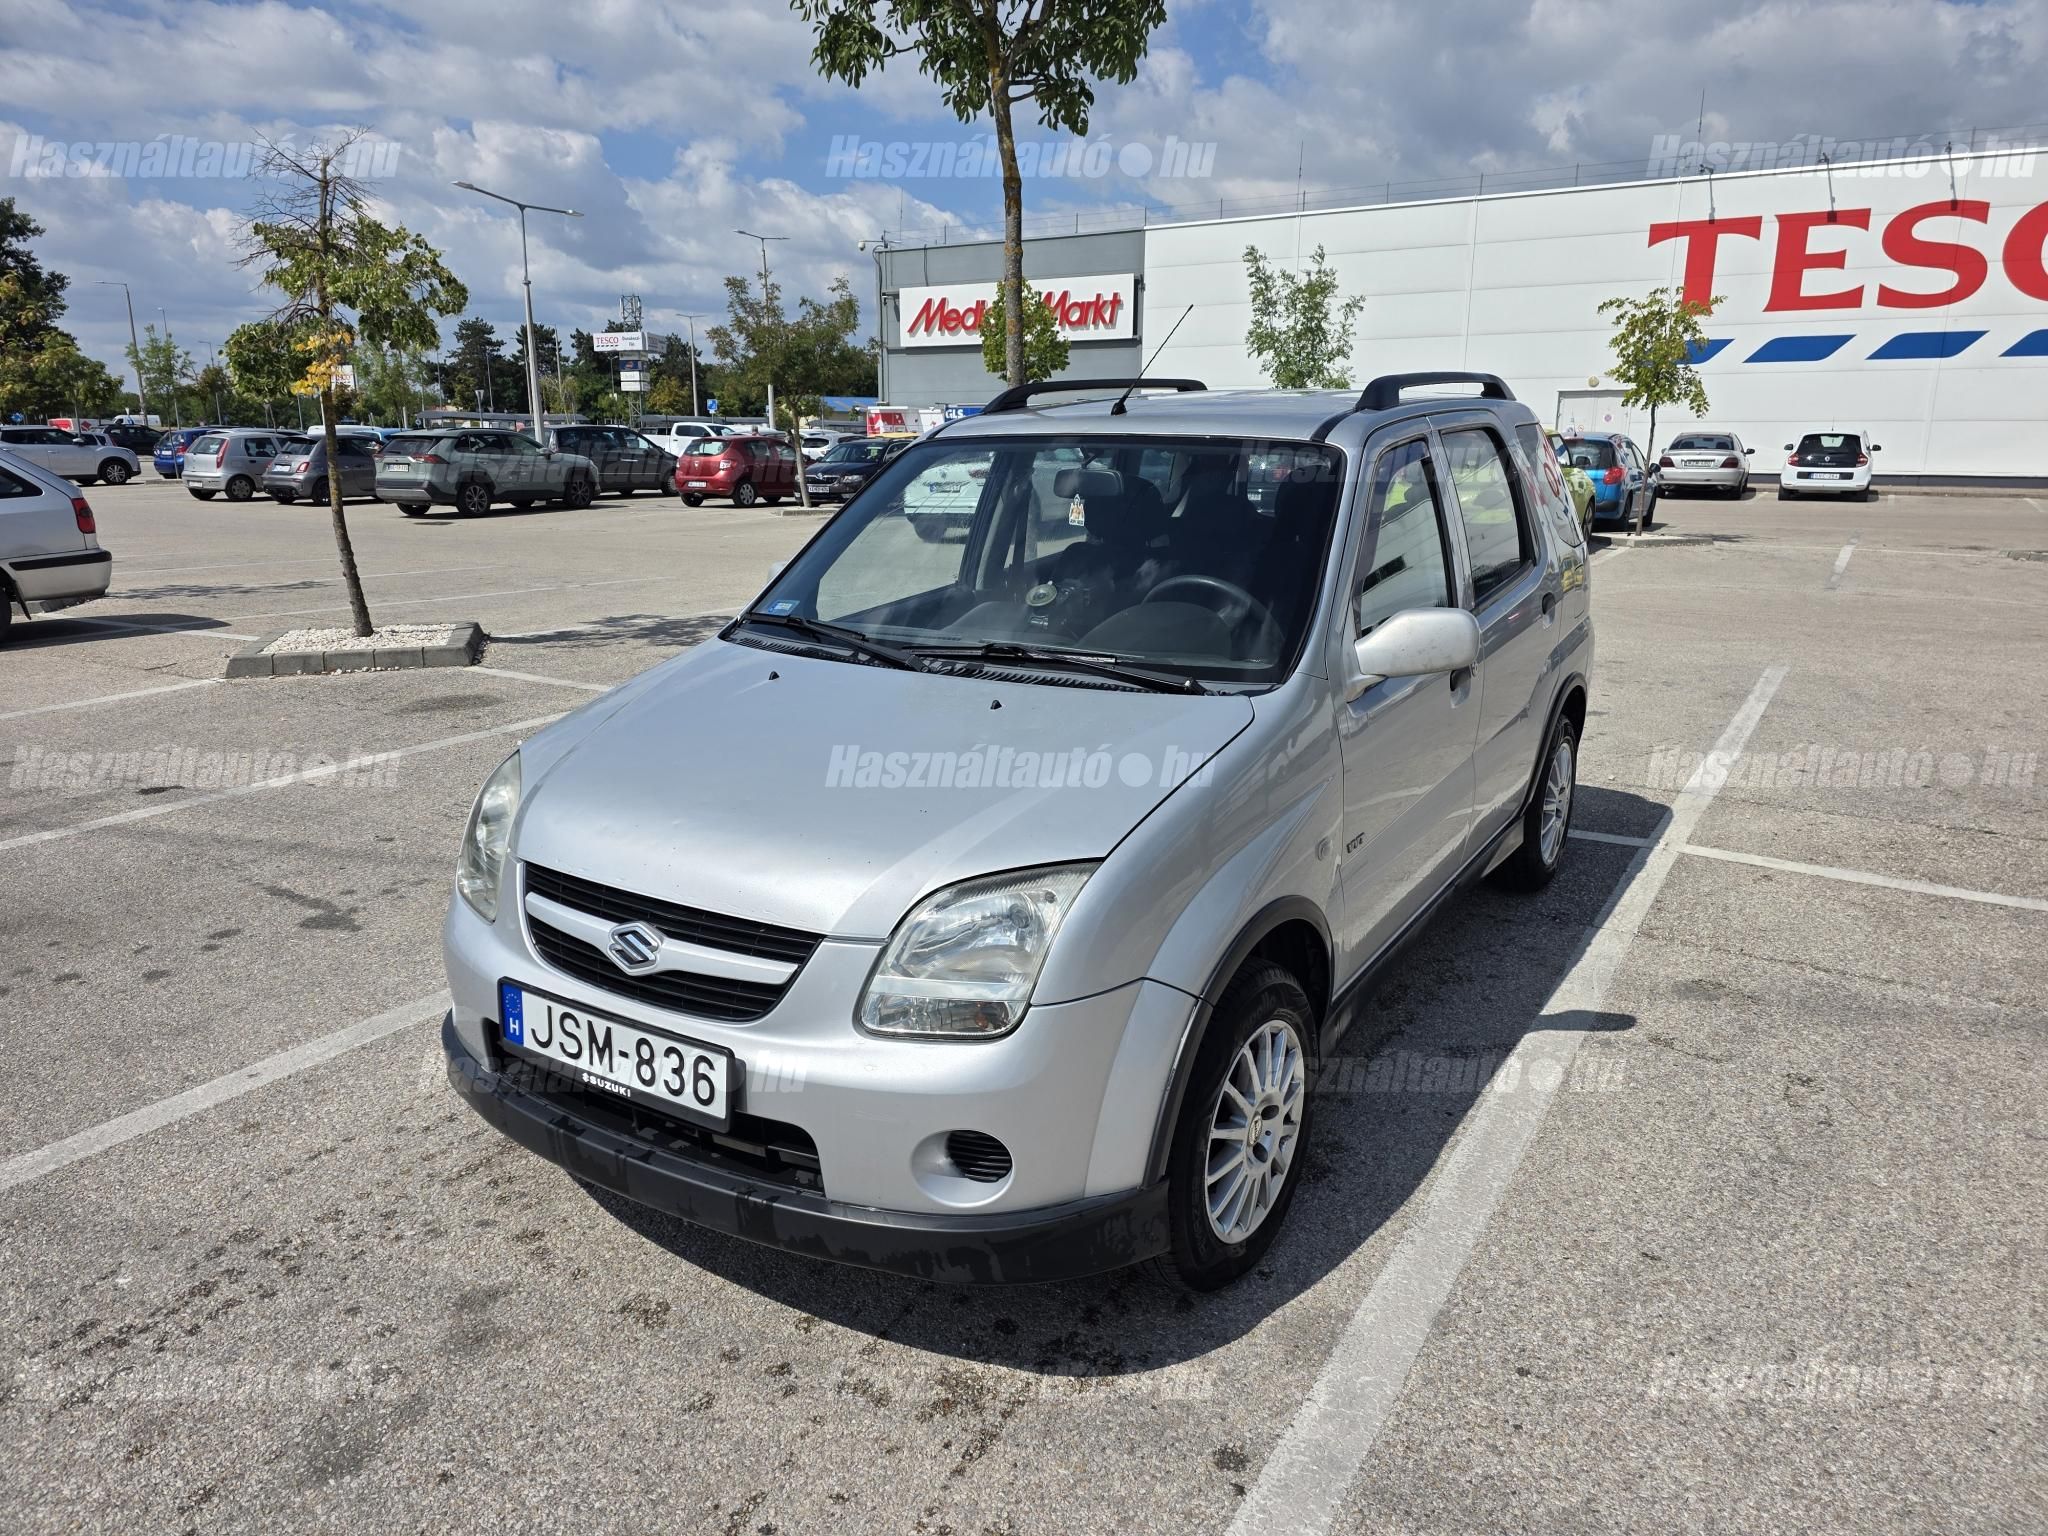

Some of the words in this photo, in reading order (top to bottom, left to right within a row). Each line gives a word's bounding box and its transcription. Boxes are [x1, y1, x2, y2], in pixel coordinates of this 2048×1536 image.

[1039, 290, 1120, 327] Markt
[596, 336, 619, 345] TESCO
[509, 1017, 520, 1036] H
[531, 1005, 716, 1106] JSM-836
[588, 1076, 631, 1098] SUZUKI
